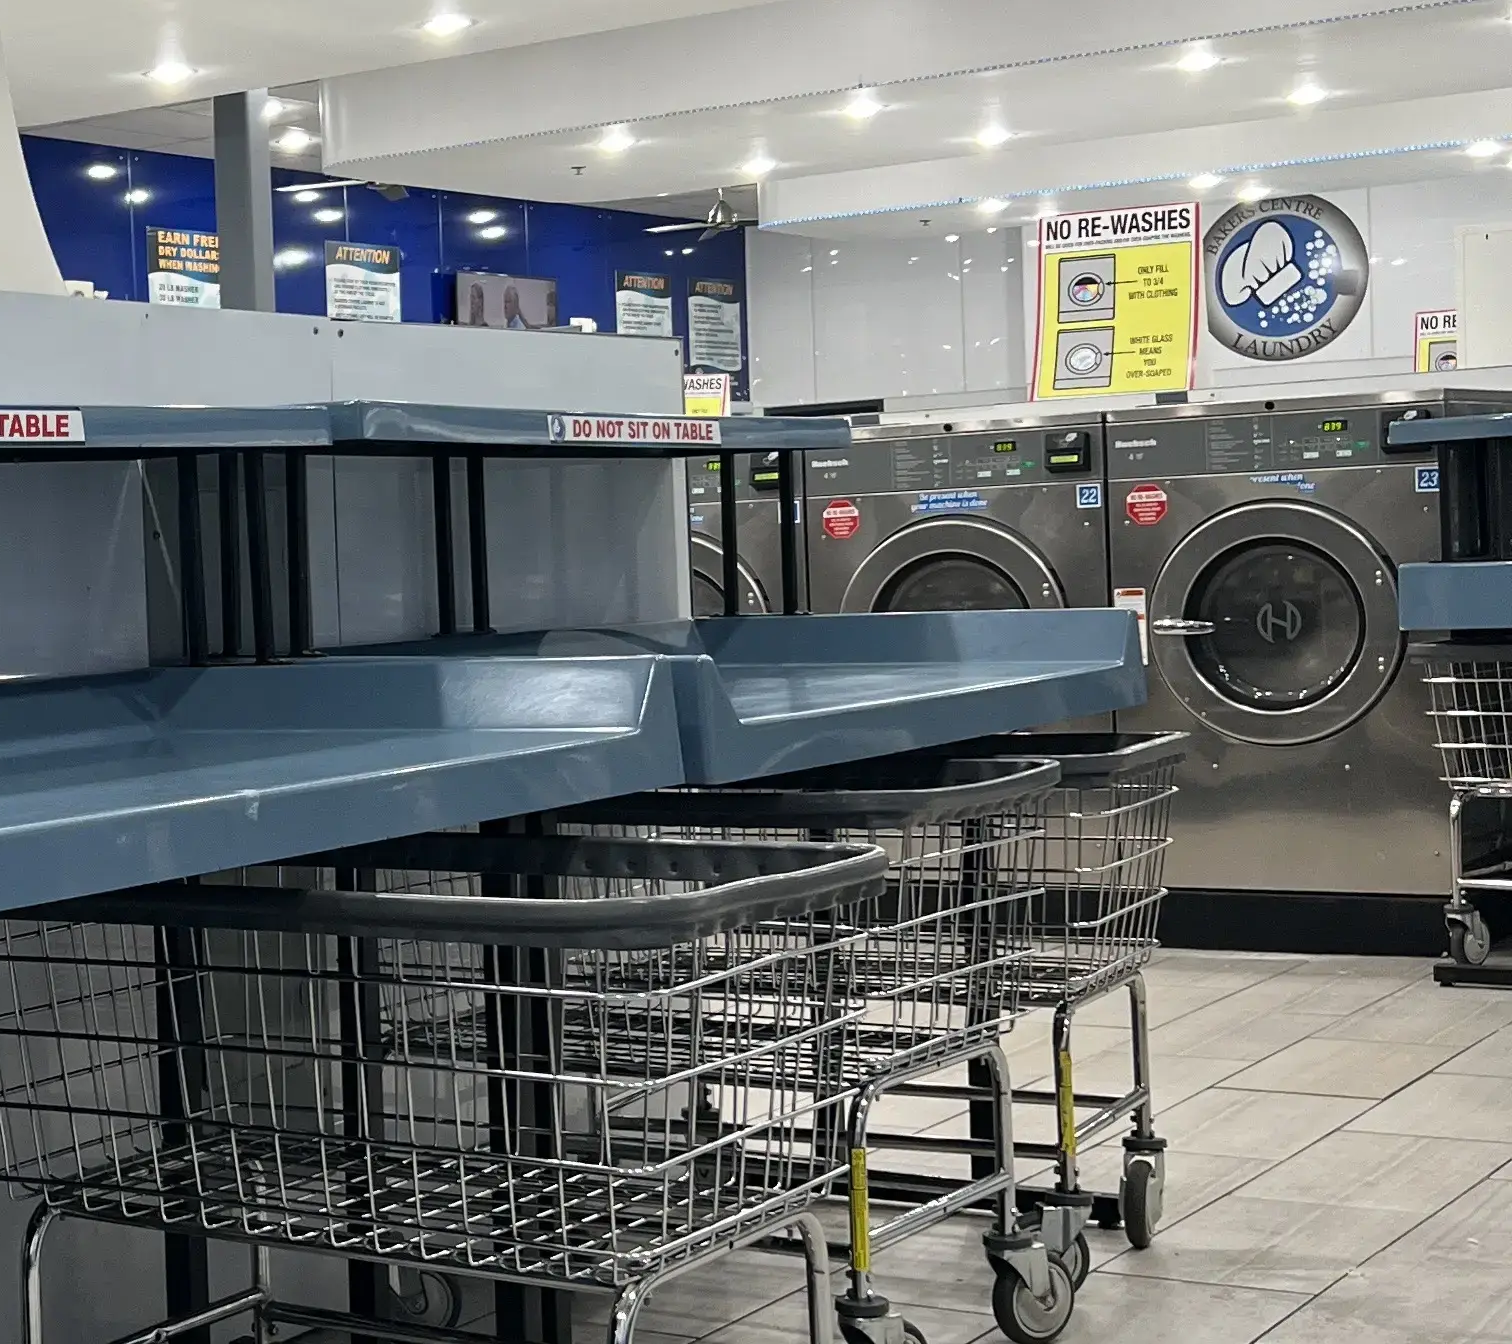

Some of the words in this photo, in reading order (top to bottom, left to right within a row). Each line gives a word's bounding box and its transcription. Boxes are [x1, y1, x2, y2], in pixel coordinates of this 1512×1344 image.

[1046, 220, 1071, 241] NO
[1078, 208, 1190, 238] RE-WASHES
[1207, 208, 1256, 256] BAKERS
[1259, 198, 1324, 220] CENTRE
[158, 231, 189, 245] EARN
[158, 246, 177, 256] DRY
[336, 247, 390, 264] ATTENTION
[158, 259, 183, 270] WHEN
[1138, 266, 1153, 274] ONLY
[1155, 265, 1168, 273] FILL
[623, 275, 665, 289] ATTENTION
[1143, 278, 1152, 286] TO
[1153, 277, 1163, 285] 3/4
[695, 282, 733, 295] ATTENTION
[1129, 292, 1144, 300] WITH
[1146, 288, 1178, 298] CLOTHING
[1421, 316, 1438, 329] NO
[1130, 336, 1149, 344] WHITE
[1152, 334, 1173, 342] GLASS
[1233, 319, 1337, 357] LAUNDRY
[1139, 347, 1162, 355] MEANS
[573, 420, 591, 437] DO
[597, 421, 623, 438] NOT
[628, 421, 648, 439] SIT
[653, 422, 670, 439] ON
[674, 423, 713, 440] TABLE
[1420, 471, 1438, 487] 23
[1081, 488, 1097, 504] 22
